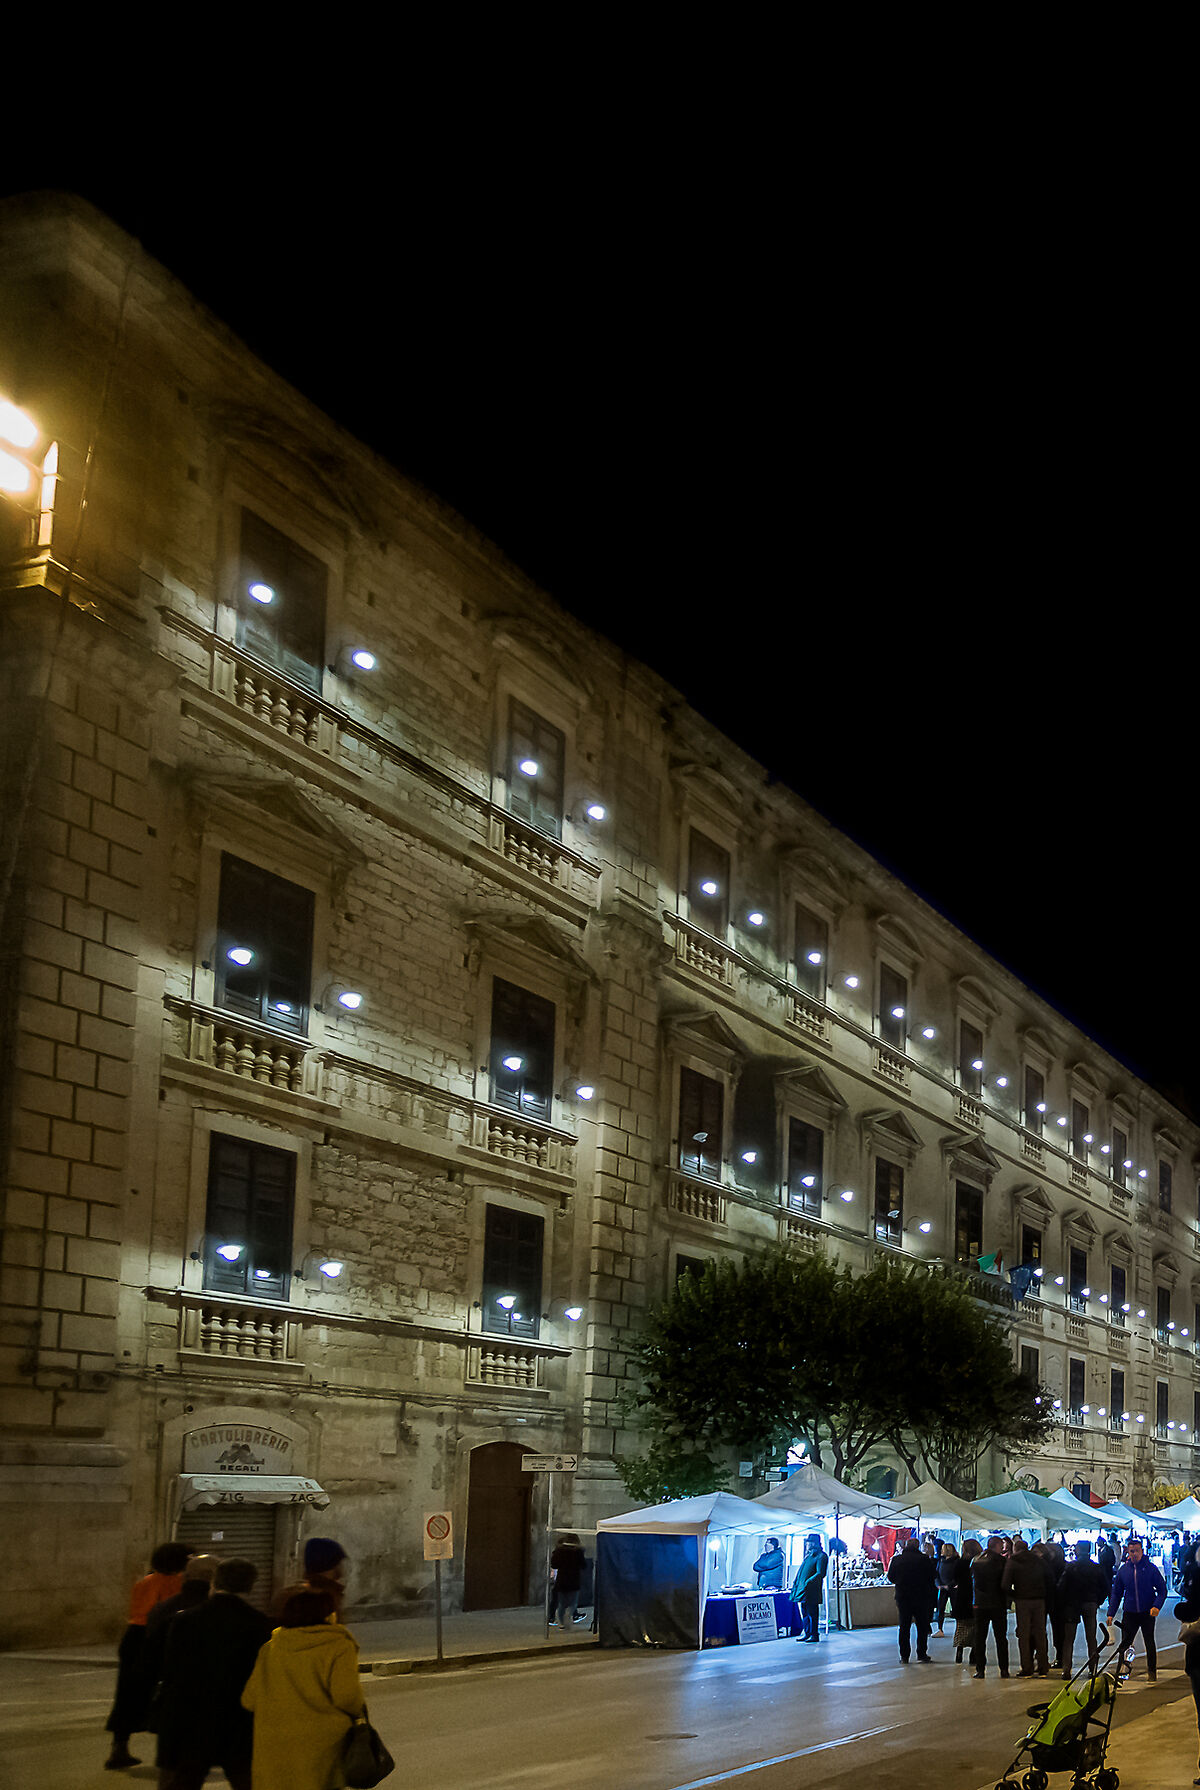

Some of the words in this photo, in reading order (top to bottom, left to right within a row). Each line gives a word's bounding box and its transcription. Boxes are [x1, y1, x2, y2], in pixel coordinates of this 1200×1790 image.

[191, 1429, 289, 1453] CARTOLIBRERIA
[219, 1464, 260, 1472] REGALI
[220, 1493, 244, 1502] ZIG
[290, 1493, 316, 1502] ZAG
